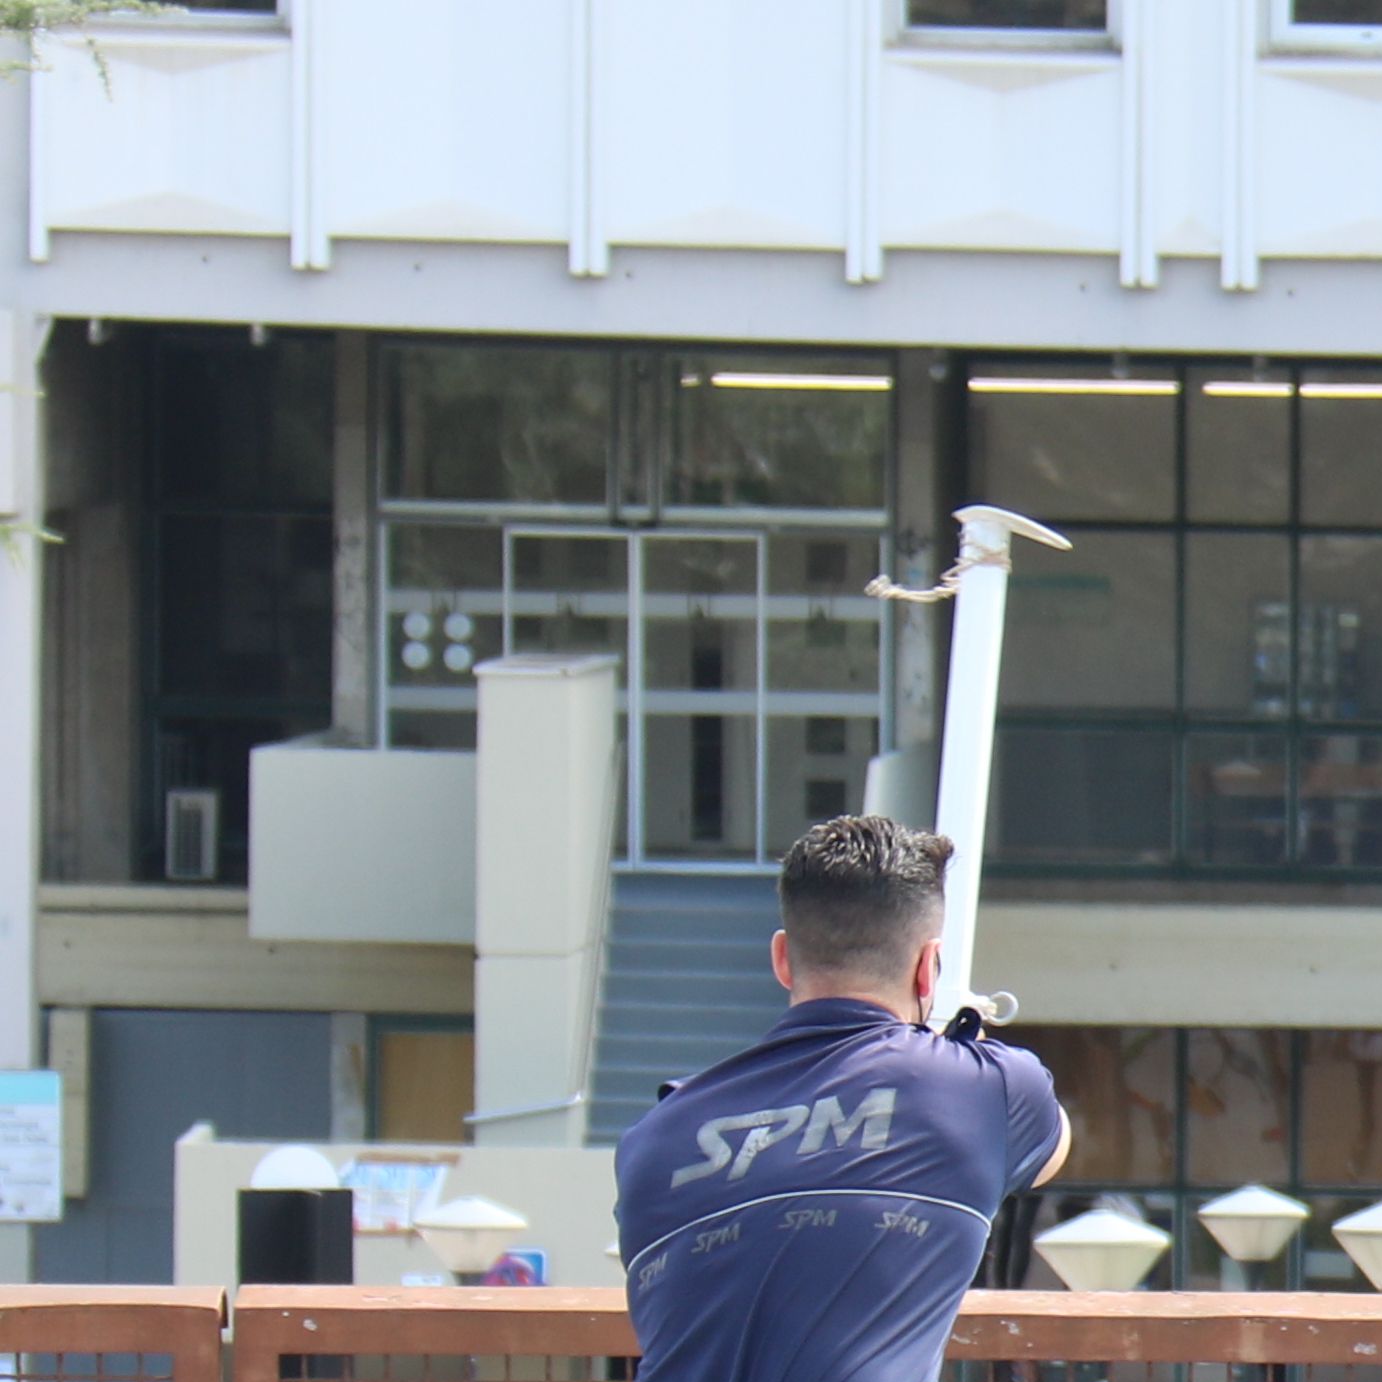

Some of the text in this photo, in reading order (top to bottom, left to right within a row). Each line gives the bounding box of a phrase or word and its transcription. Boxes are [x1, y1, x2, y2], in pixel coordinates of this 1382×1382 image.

[671, 1088, 897, 1189] SPM
[638, 1209, 930, 1292] SPM SPM SPM SPM
